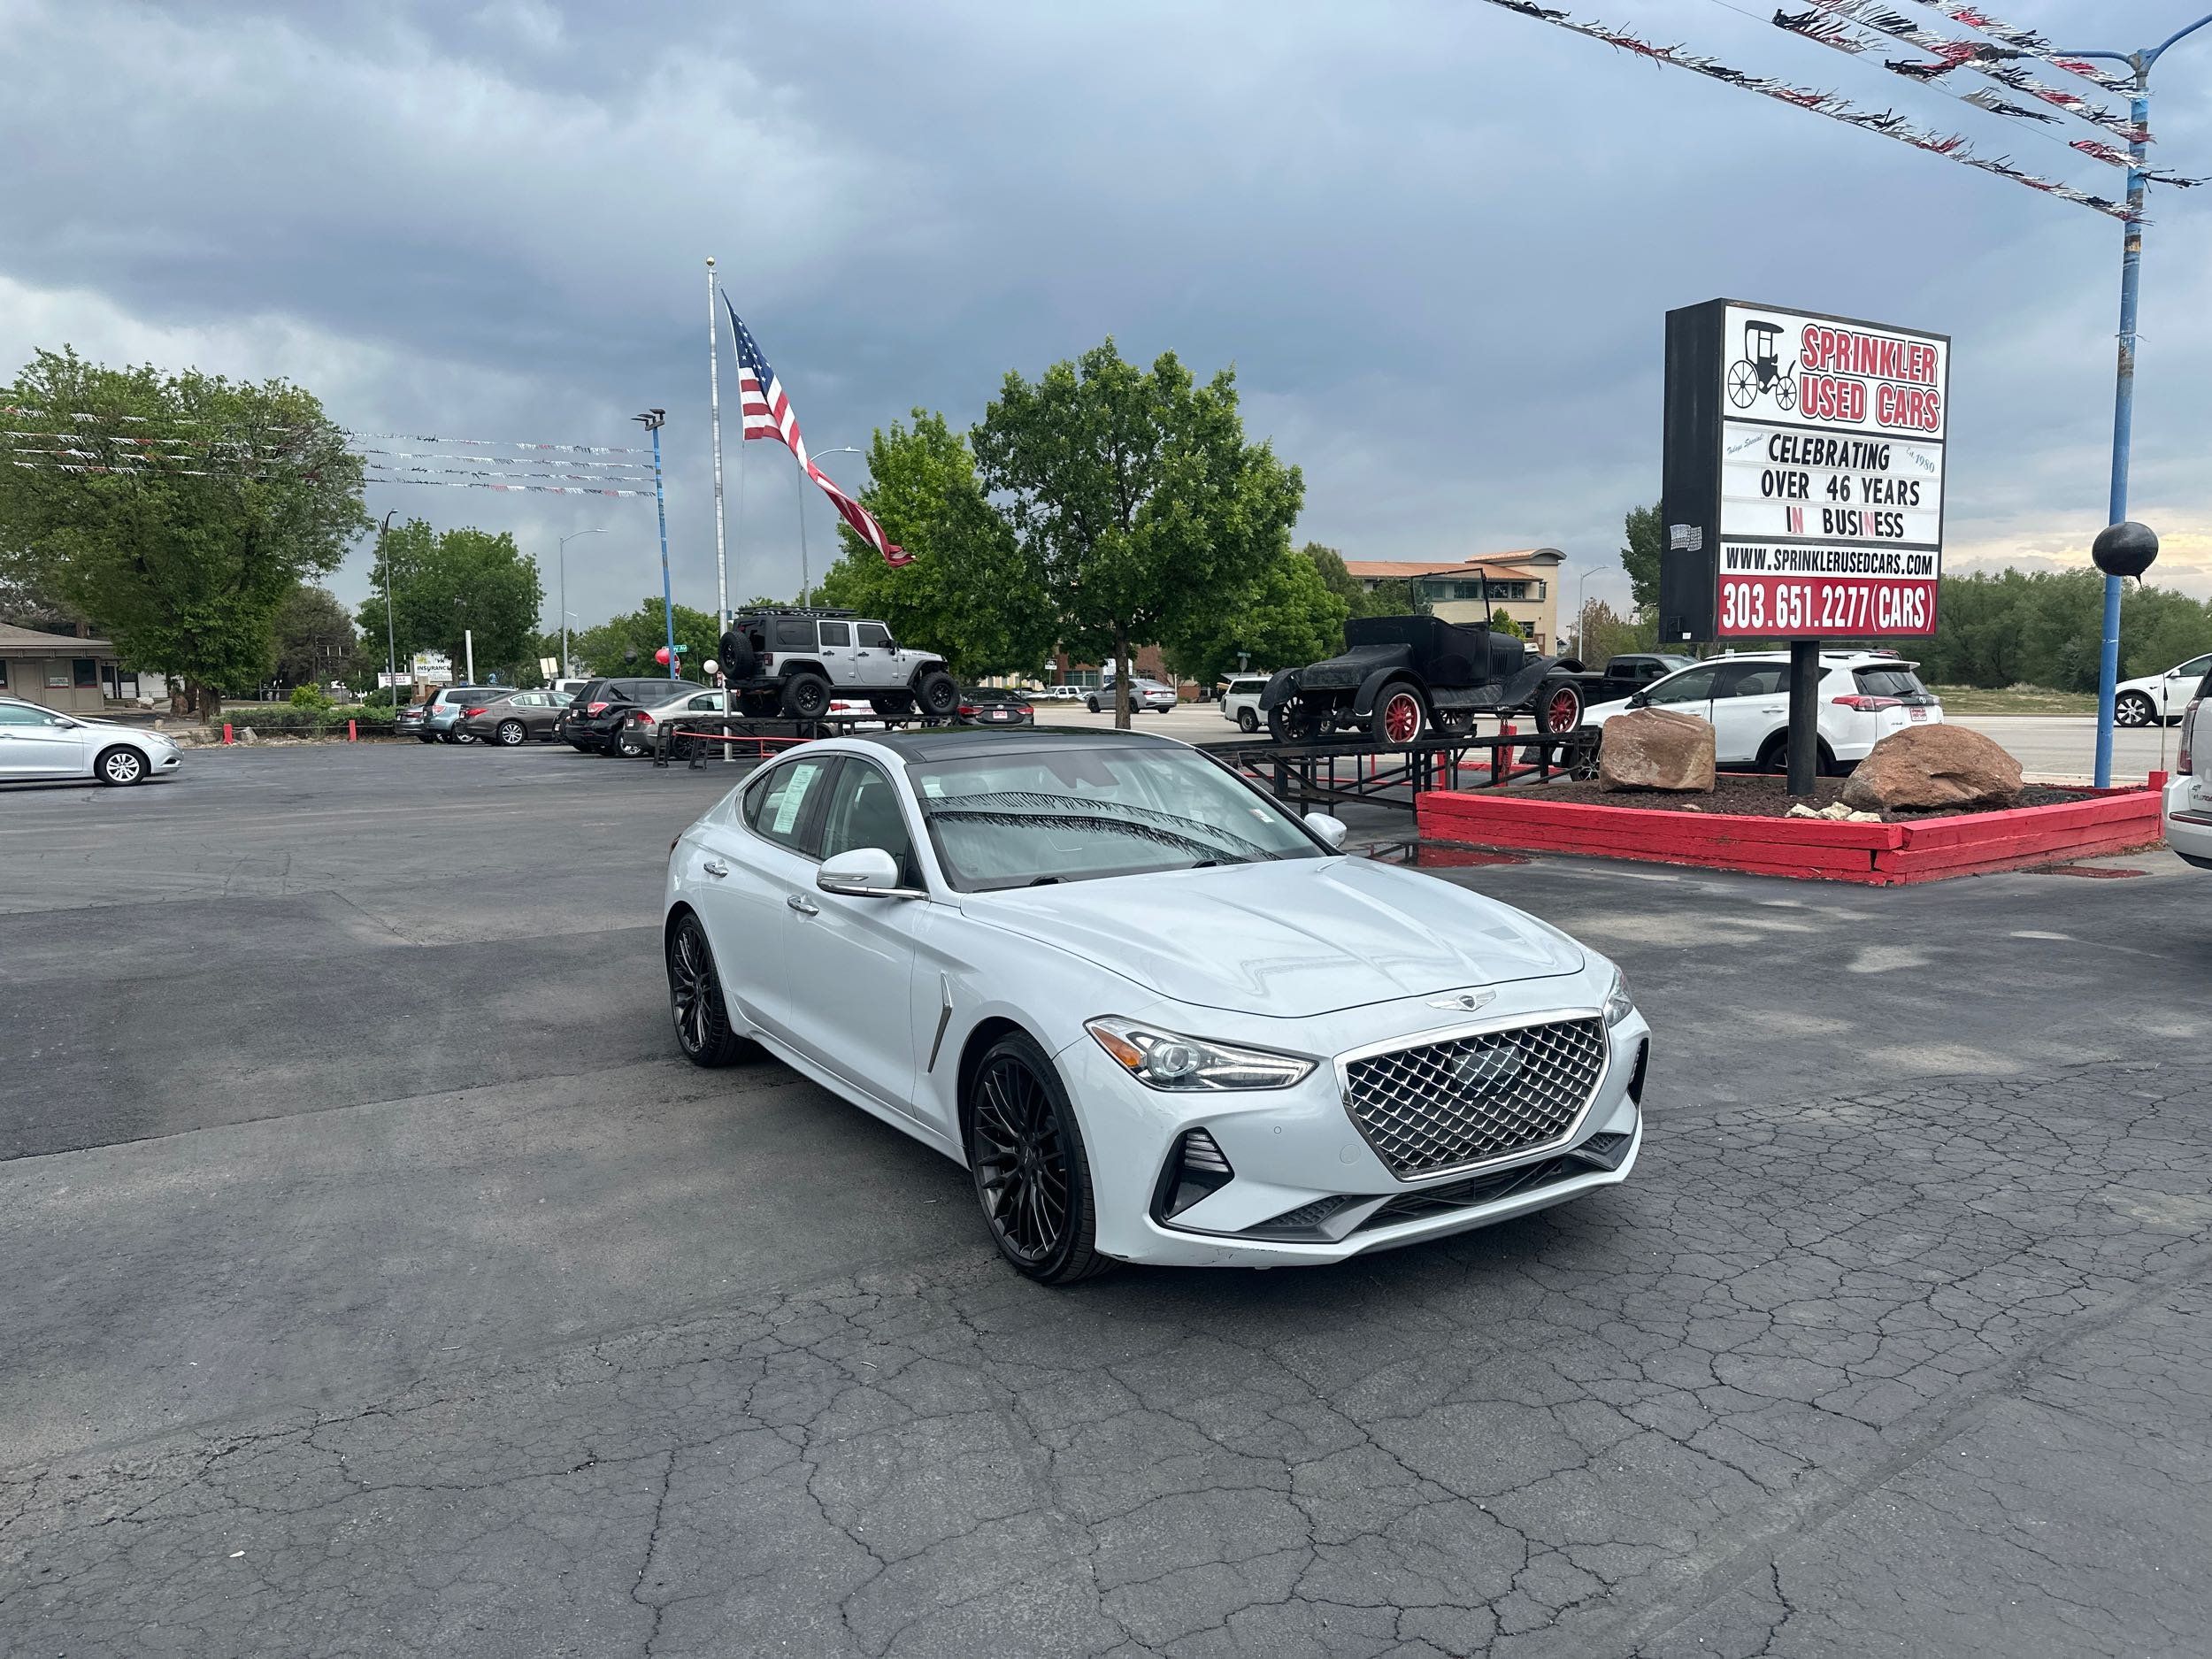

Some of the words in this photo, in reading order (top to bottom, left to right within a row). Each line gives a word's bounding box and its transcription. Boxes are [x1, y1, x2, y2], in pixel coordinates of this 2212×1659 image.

[1801, 324, 1938, 387] SPRINKLER
[1799, 374, 1867, 423] USED
[1877, 382, 1940, 433] CARS
[1769, 433, 1890, 471] CELEBRATING
[1915, 454, 1935, 473] 1980
[1761, 469, 1809, 499] OVER
[1826, 474, 1851, 502] 46
[1862, 478, 1920, 507] YEARS
[1786, 505, 1804, 534] IN
[1823, 507, 1904, 538] BUSINESS
[1726, 547, 1932, 576] WWW.SPRINKLERUSEDCARS.COM
